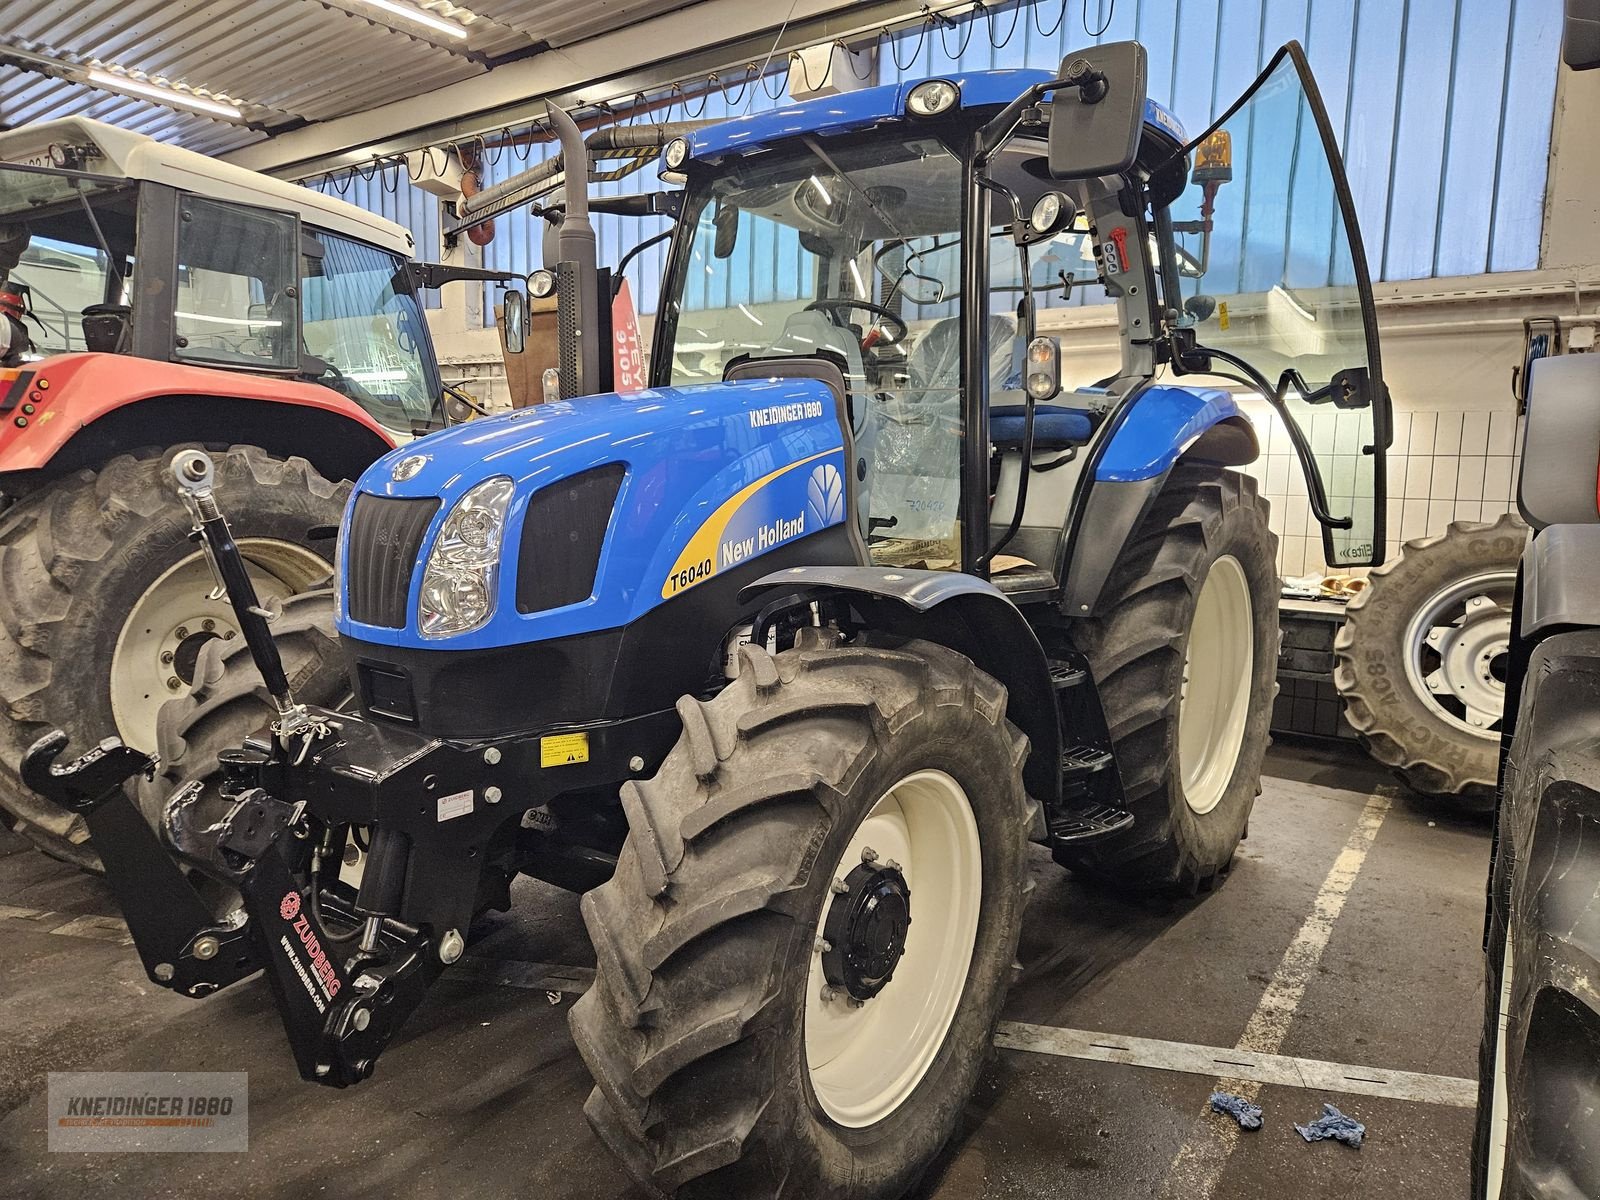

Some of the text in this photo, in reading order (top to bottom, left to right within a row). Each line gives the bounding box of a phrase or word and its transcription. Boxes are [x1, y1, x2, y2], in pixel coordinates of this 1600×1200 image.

[616, 330, 632, 386] 9105
[626, 321, 644, 391] STEY
[750, 401, 823, 428] KNEIDINGER 1880
[721, 510, 805, 567] New Holland
[670, 558, 712, 593] T6040
[280, 935, 326, 1015] WWW.ZUIDBERG.COM
[293, 913, 342, 997] ZUIDBERG
